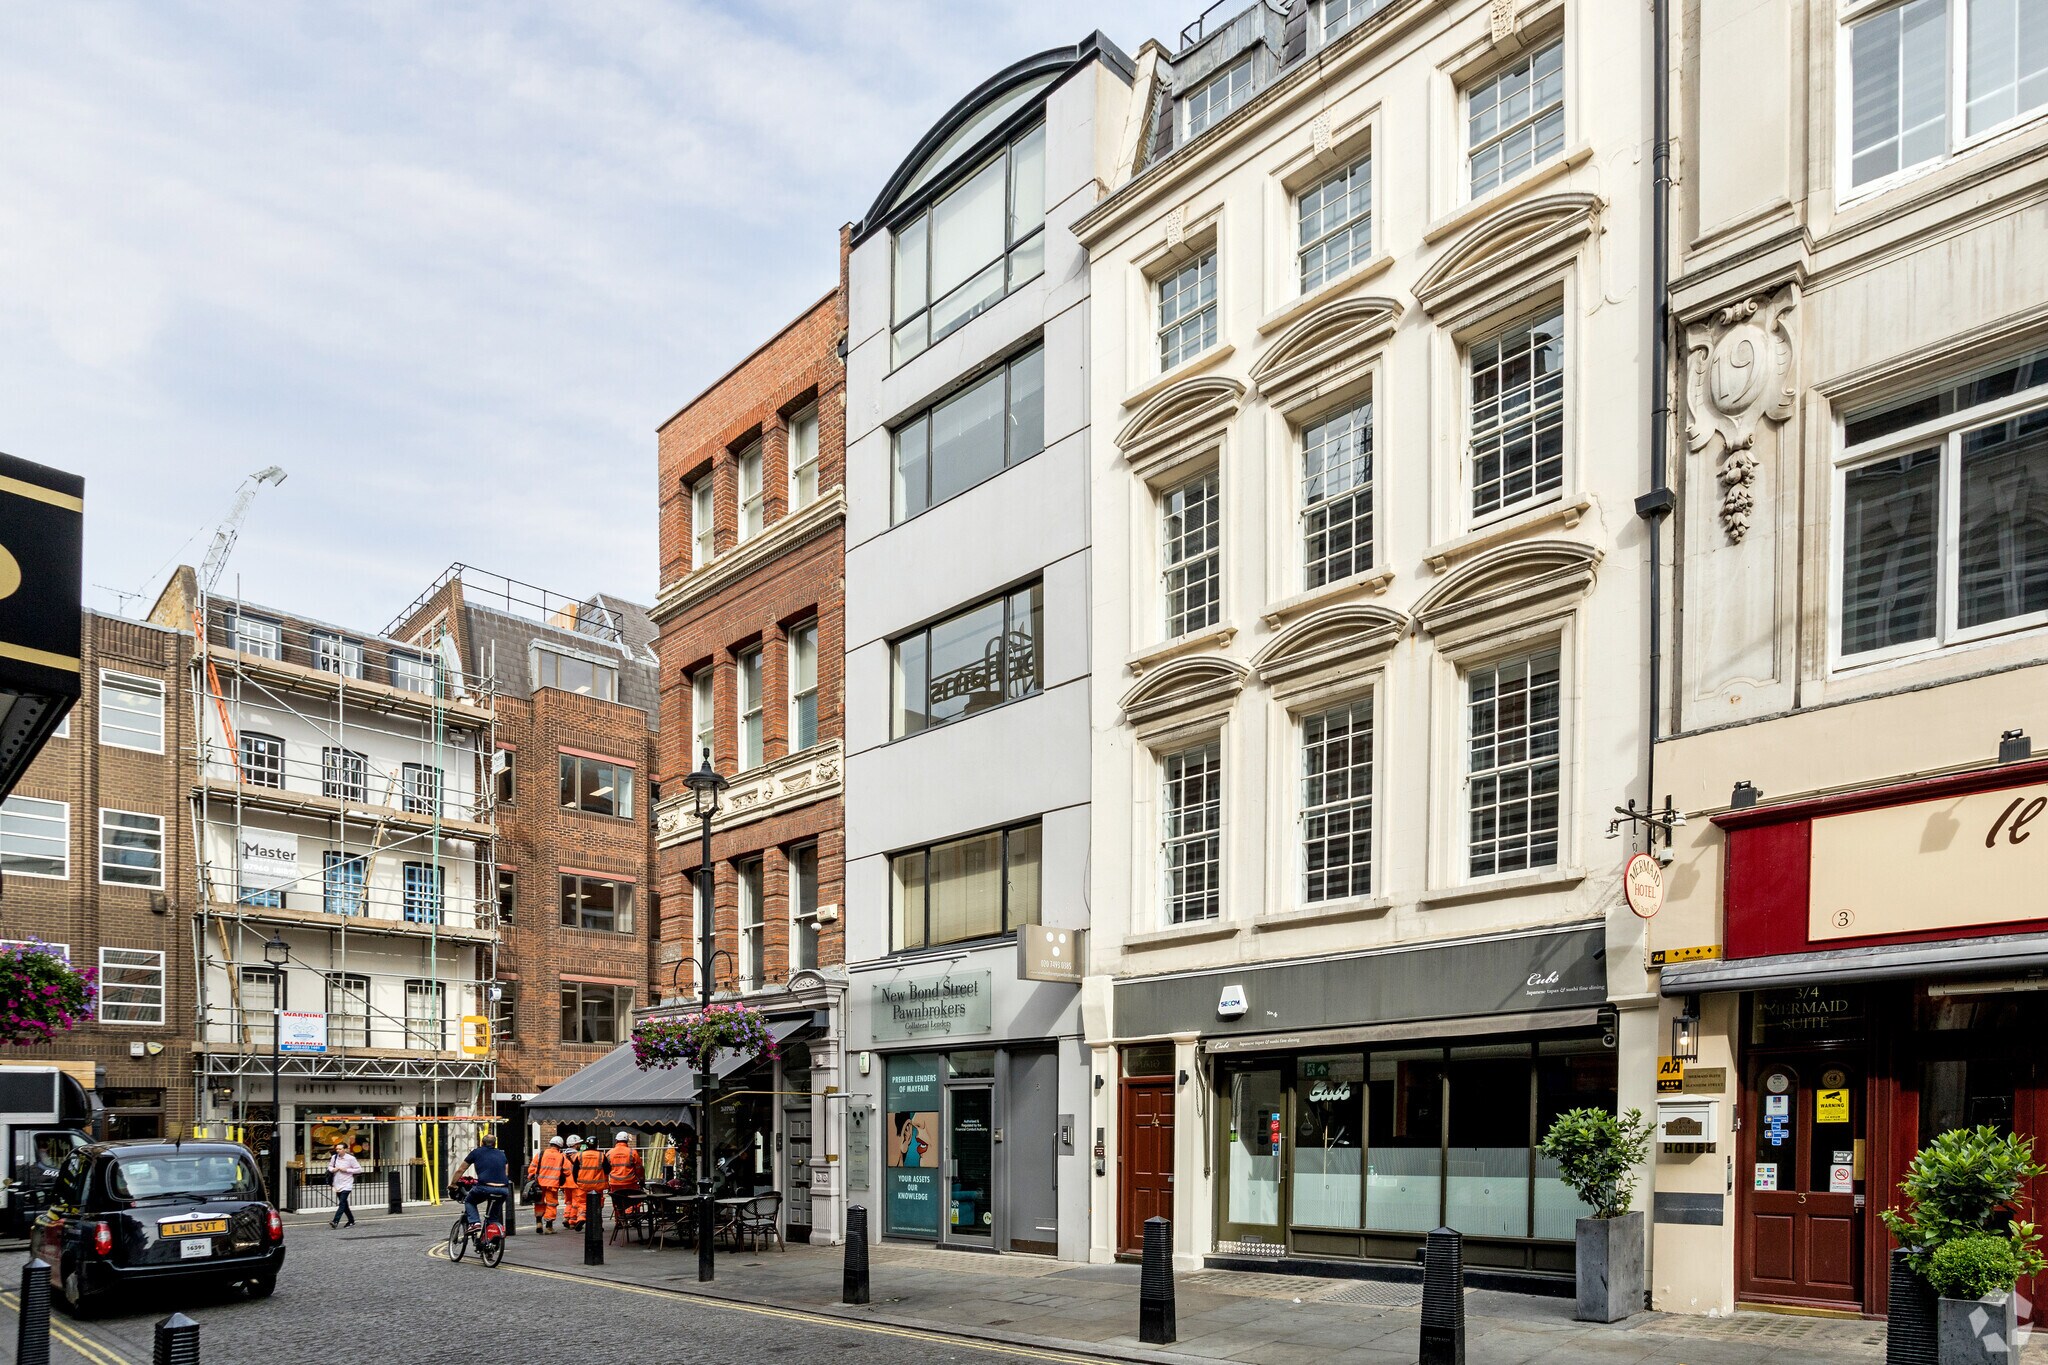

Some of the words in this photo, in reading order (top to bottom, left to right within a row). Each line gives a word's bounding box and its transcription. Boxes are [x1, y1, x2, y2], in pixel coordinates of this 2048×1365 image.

[244, 842, 297, 860] Master
[1629, 859, 1661, 888] MERMAID
[1634, 883, 1656, 899] HOTEL
[1837, 911, 1849, 927] 3
[1653, 953, 1663, 962] AA
[881, 987, 906, 1004] New
[909, 981, 939, 1001] Bond
[942, 979, 978, 997] Street
[1795, 986, 1820, 999] 3/4
[893, 999, 966, 1021] Pawnbrokers
[905, 1020, 930, 1031] Collateral
[930, 1020, 952, 1030] Lenders
[1782, 1016, 1830, 1030] SUITE
[1660, 1061, 1681, 1074] AA
[892, 1075, 914, 1084] PREMIER
[914, 1074, 937, 1083] LENDERS
[295, 1083, 337, 1094] HANINA
[358, 1084, 403, 1096] GALLERY
[898, 1085, 906, 1093] OF
[906, 1084, 930, 1093] MAYFAIR
[1151, 1112, 1160, 1127] 4
[1664, 1142, 1716, 1154] HOTEL
[898, 1175, 912, 1183] YOUR
[912, 1175, 931, 1183] ASSETS
[898, 1192, 928, 1201] KNOWLEDGE
[1797, 1192, 1807, 1204] 3
[196, 1221, 217, 1232] SVT
